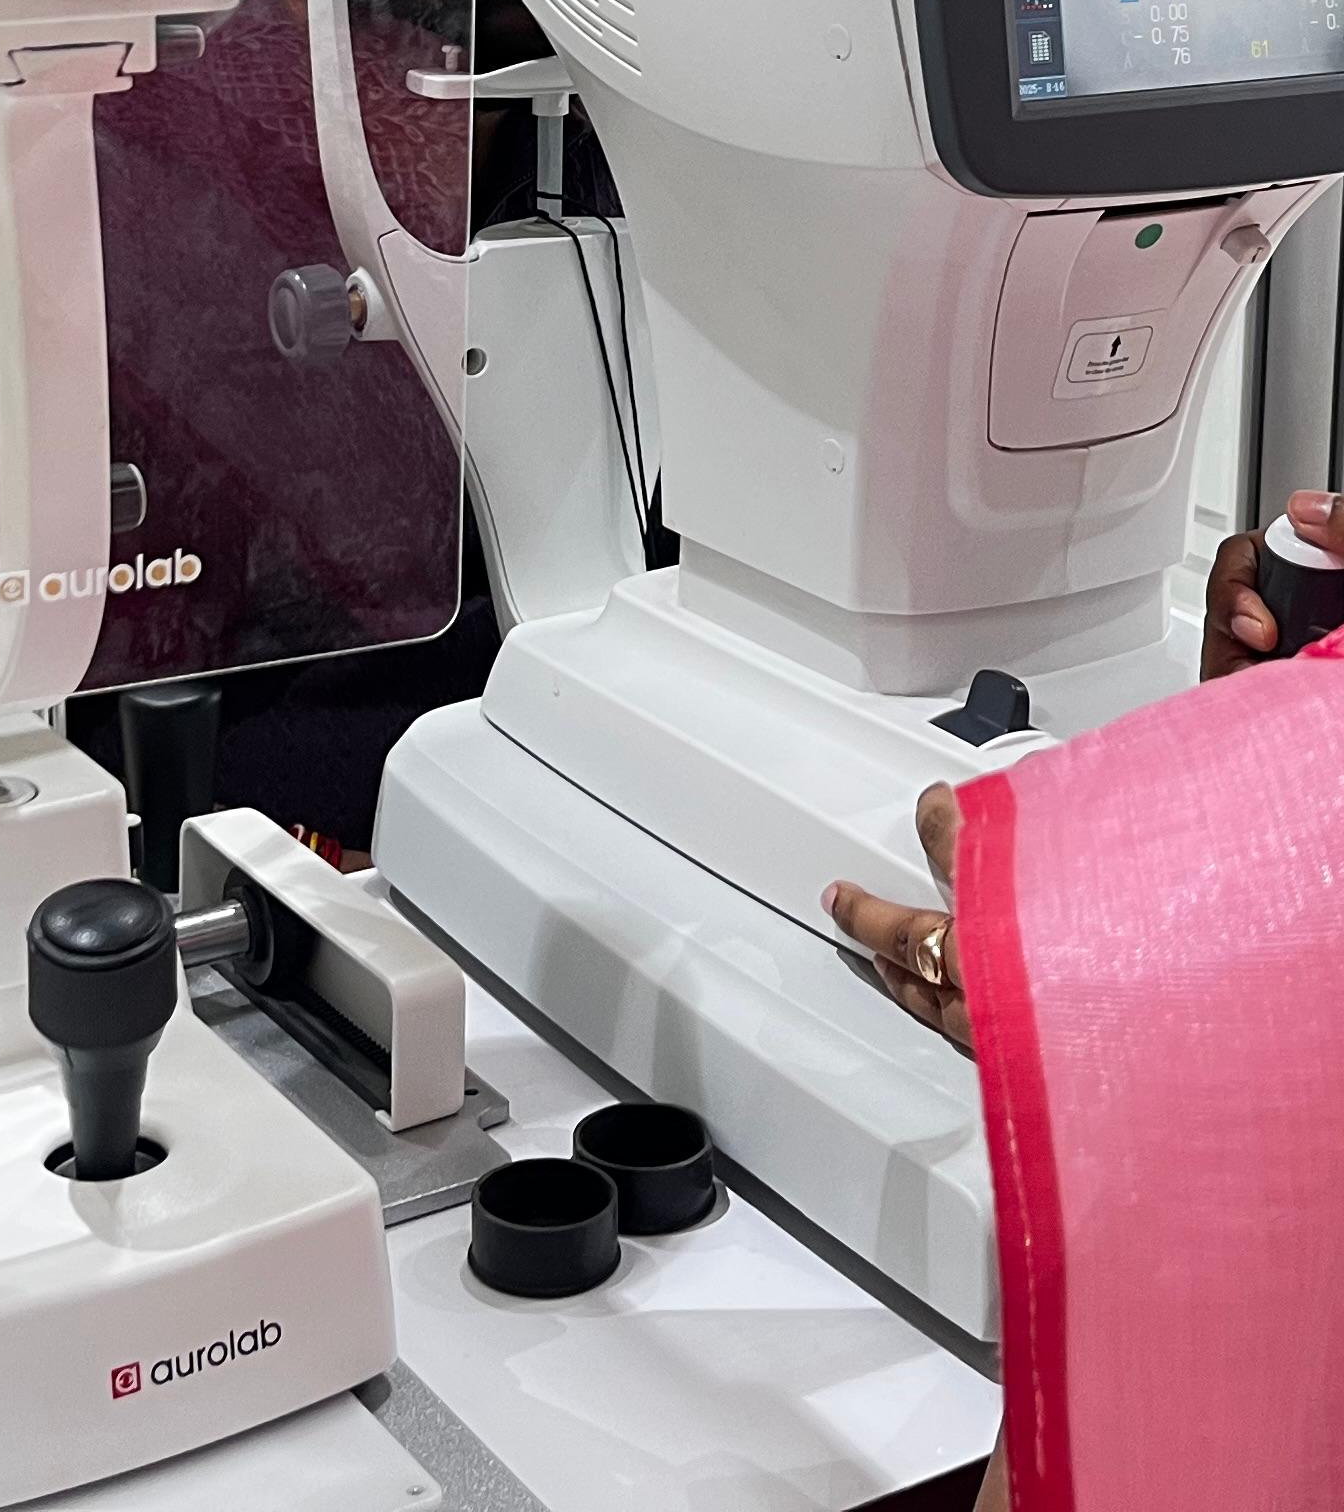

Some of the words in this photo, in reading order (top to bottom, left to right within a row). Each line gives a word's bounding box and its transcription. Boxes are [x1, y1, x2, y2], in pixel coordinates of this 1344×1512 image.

[1171, 47, 1191, 66] 76
[38, 548, 202, 602] aurolab
[150, 1319, 282, 1385] aurolab
